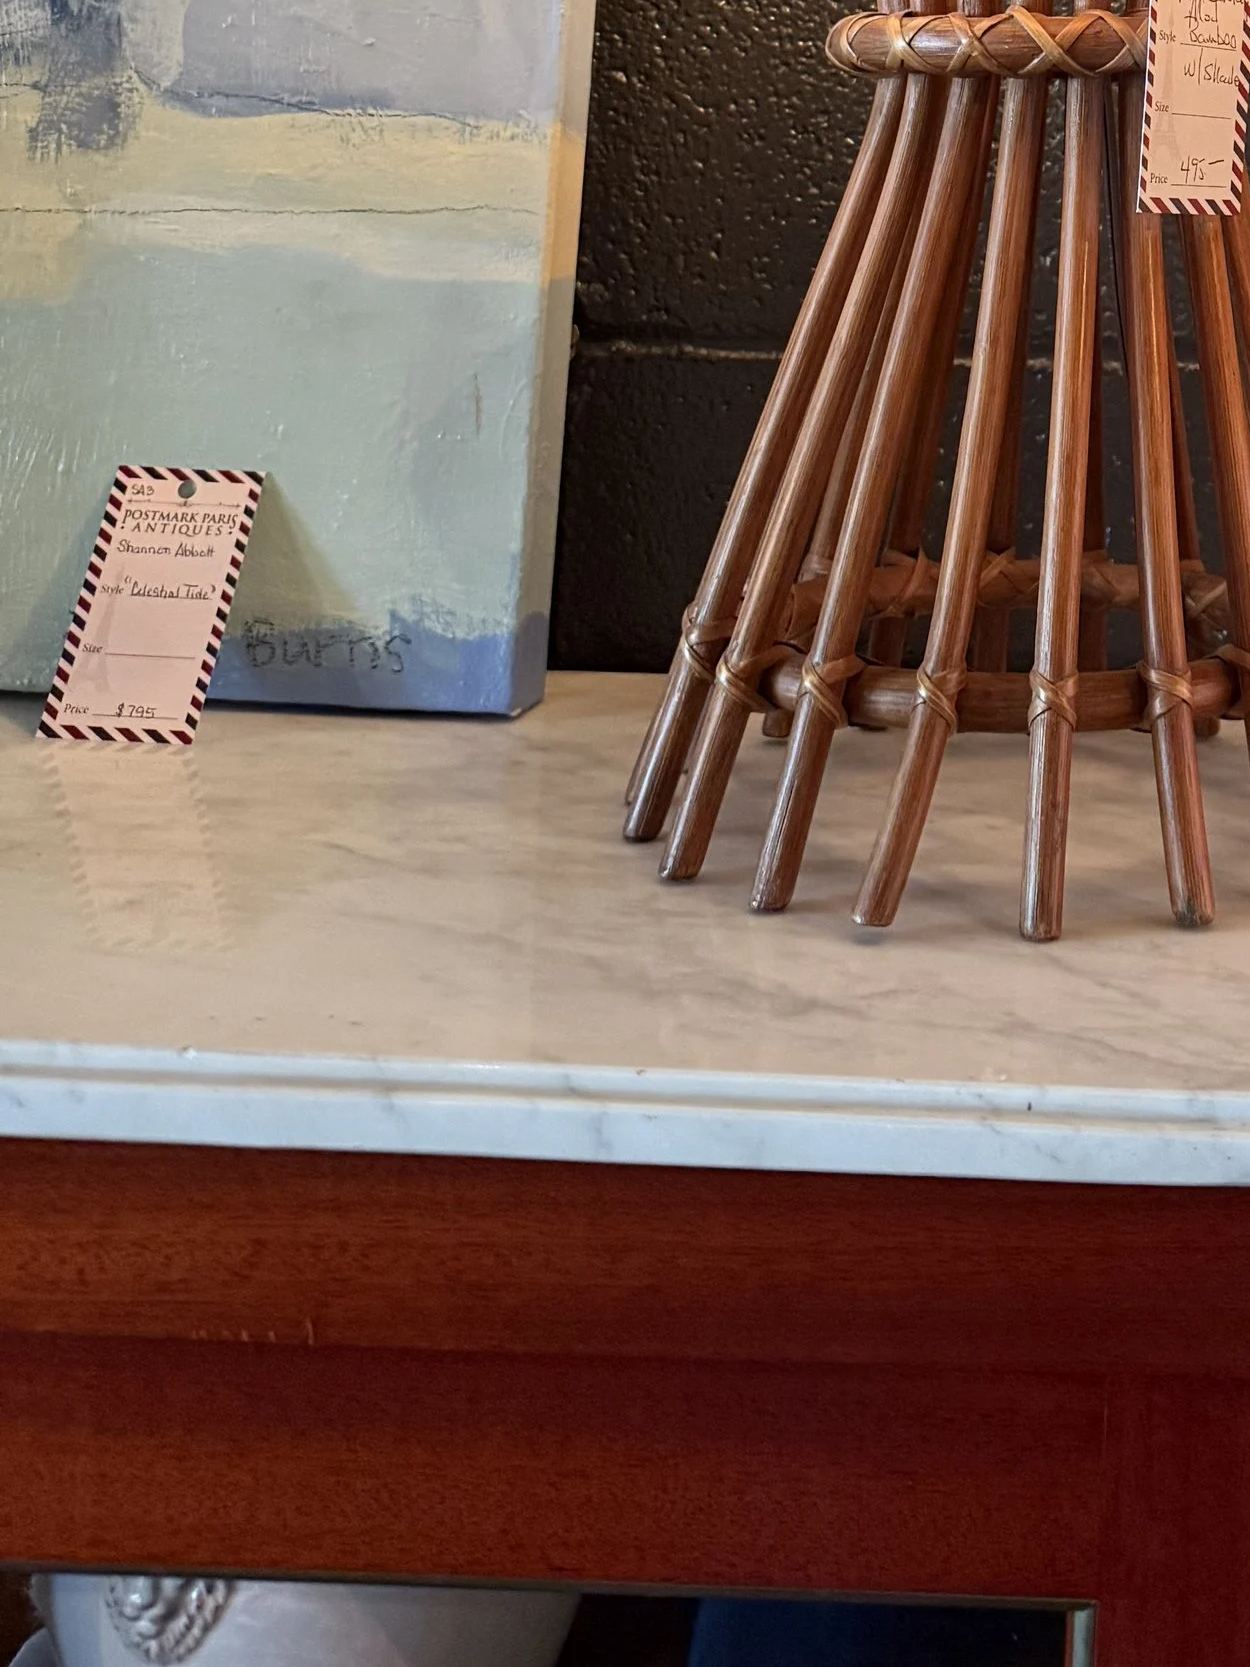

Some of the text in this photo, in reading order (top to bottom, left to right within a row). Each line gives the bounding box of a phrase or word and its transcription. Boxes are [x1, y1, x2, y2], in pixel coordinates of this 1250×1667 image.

[1159, 29, 1177, 44] Style
[1154, 101, 1170, 113] Size
[1150, 172, 1168, 184] Price
[122, 509, 239, 530] POSTMARK PARIS
[131, 522, 223, 537] ANTIQUES
[116, 539, 216, 558] Shannon Abbott
[100, 584, 125, 595] Style
[82, 642, 103, 654] Size
[63, 703, 90, 715] Price
